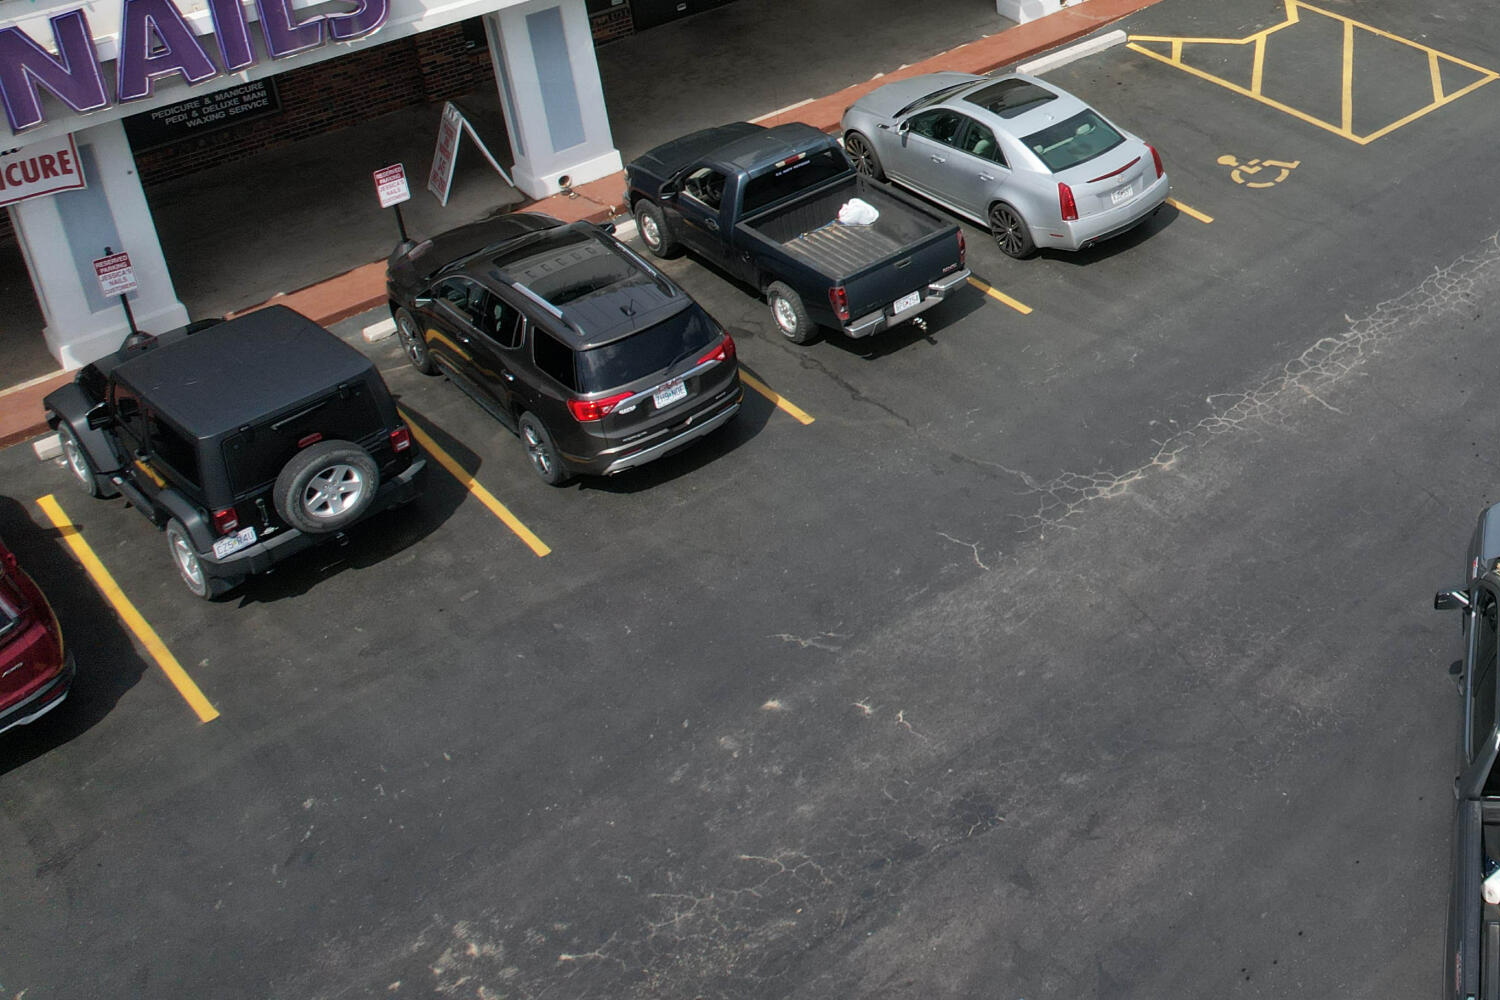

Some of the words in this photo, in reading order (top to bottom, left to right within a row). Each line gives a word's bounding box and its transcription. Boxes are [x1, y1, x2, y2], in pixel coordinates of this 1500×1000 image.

[151, 100, 200, 120] PEDICURE
[204, 97, 212, 105] &
[215, 81, 264, 102] MANICURE
[165, 113, 189, 125] PEDI
[191, 109, 199, 117] &
[202, 97, 240, 114] DELUXE
[242, 90, 268, 103] MANI
[186, 111, 226, 128] WAXING
[229, 98, 270, 116] SERVICE
[95, 254, 128, 268] RESERVED
[99, 262, 128, 274] PARKING
[108, 276, 128, 286] NAILS
